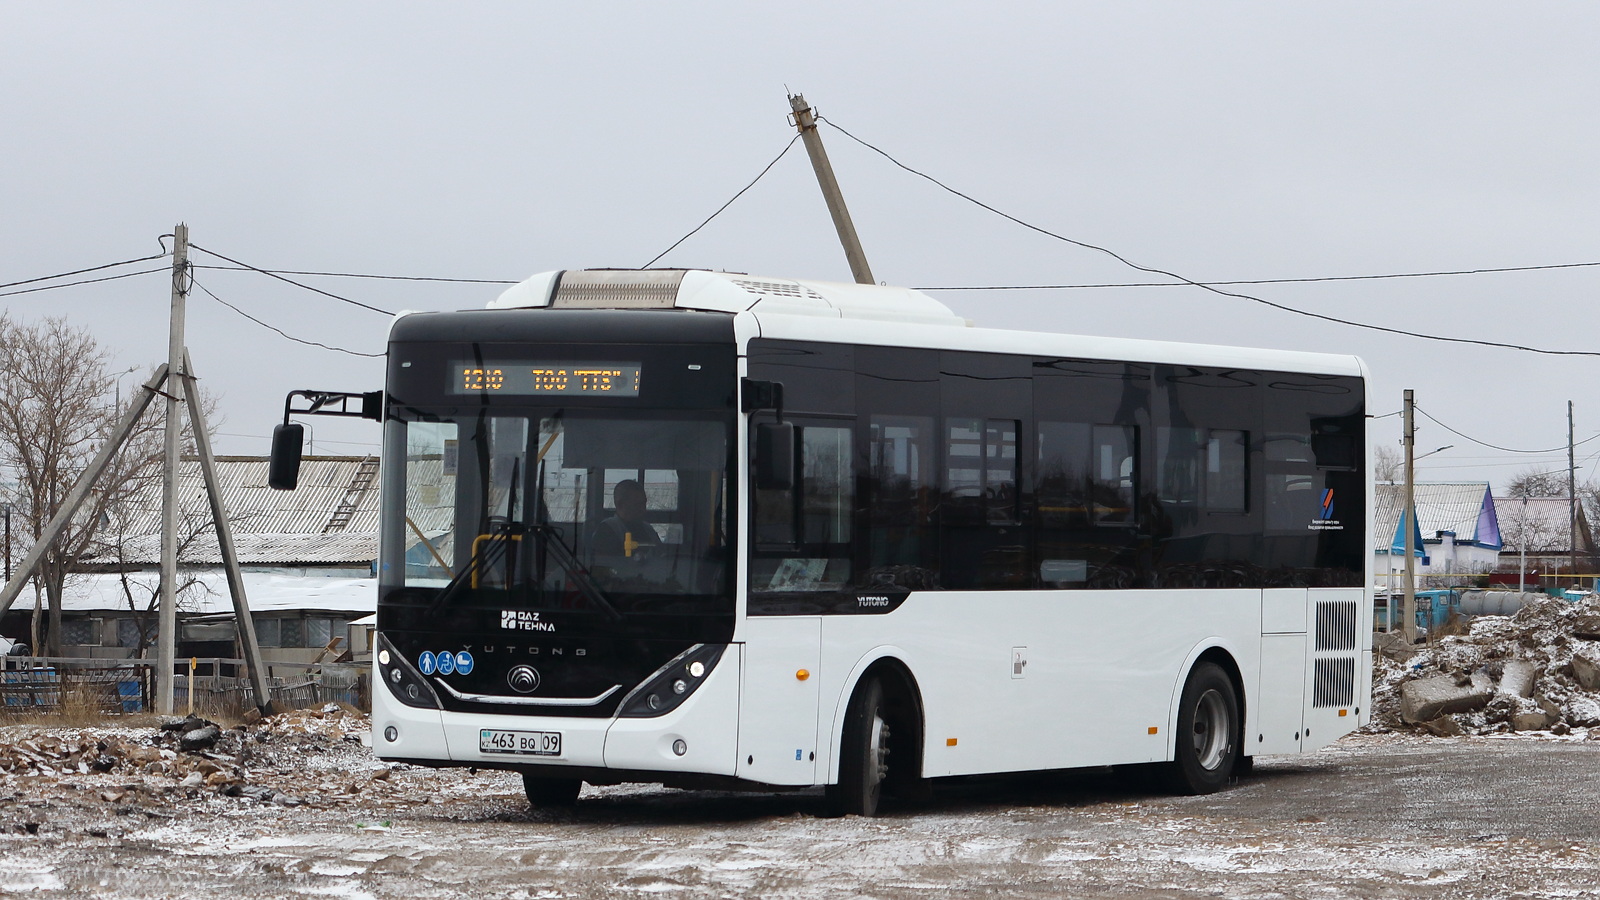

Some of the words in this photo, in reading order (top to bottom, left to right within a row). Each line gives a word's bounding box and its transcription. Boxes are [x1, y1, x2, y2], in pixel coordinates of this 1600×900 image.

[856, 596, 889, 607] YUTONG
[517, 612, 540, 621] QAZ
[517, 620, 556, 632] TEHNA
[463, 645, 586, 656] YUTONG
[481, 740, 491, 748] KZ
[491, 733, 515, 749] 463
[520, 737, 536, 750] BQ
[542, 735, 559, 751] 09
